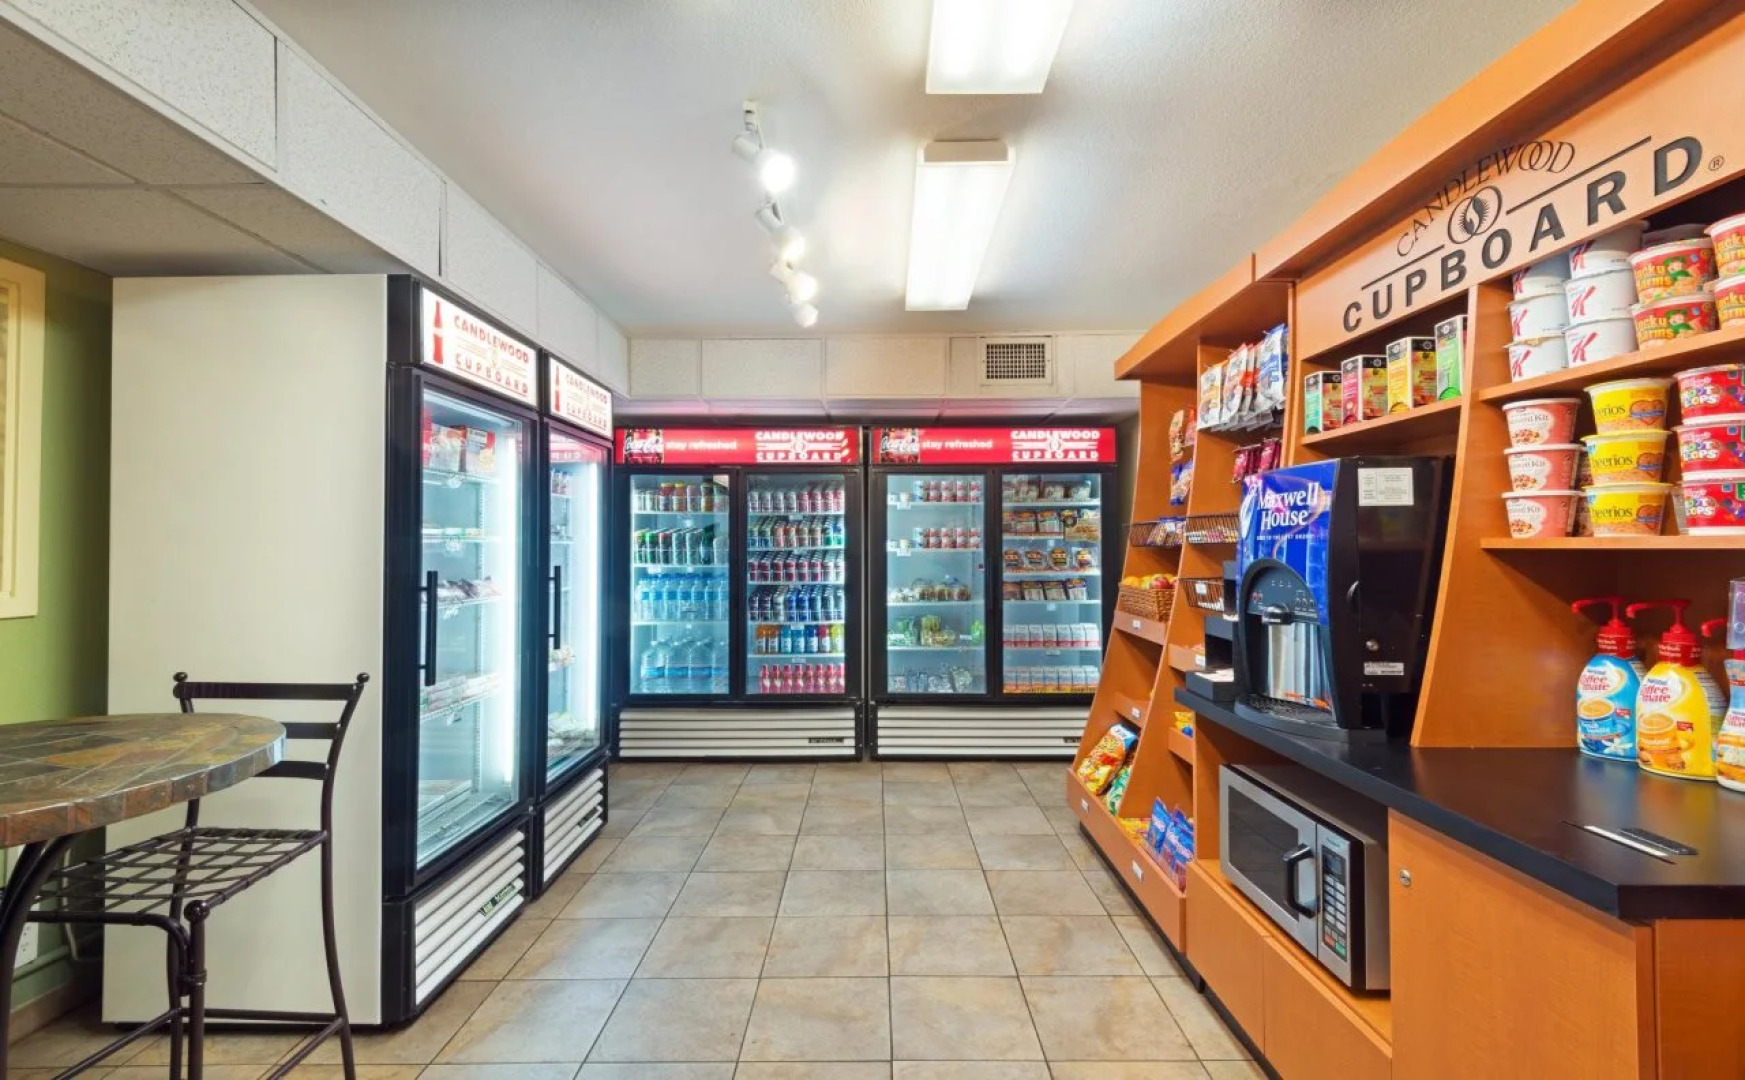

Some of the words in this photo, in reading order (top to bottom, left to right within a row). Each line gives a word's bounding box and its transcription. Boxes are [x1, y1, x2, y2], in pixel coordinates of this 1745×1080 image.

[1396, 140, 1576, 257] CANDLEWOOD
[453, 315, 530, 365] CANDLEWOOD
[454, 353, 529, 395] CUPBOARD
[755, 430, 845, 441] CANDLEWOOD
[1010, 430, 1101, 440] CANDLEWOOD
[665, 440, 687, 451] stay
[690, 439, 738, 451] refreshed
[922, 440, 943, 451] stay
[945, 439, 993, 450] refreshed
[756, 452, 843, 462] CUPBOARD
[1011, 451, 1099, 460] CUPBOARD
[1257, 482, 1319, 510] Maxwell
[1260, 509, 1310, 530] House
